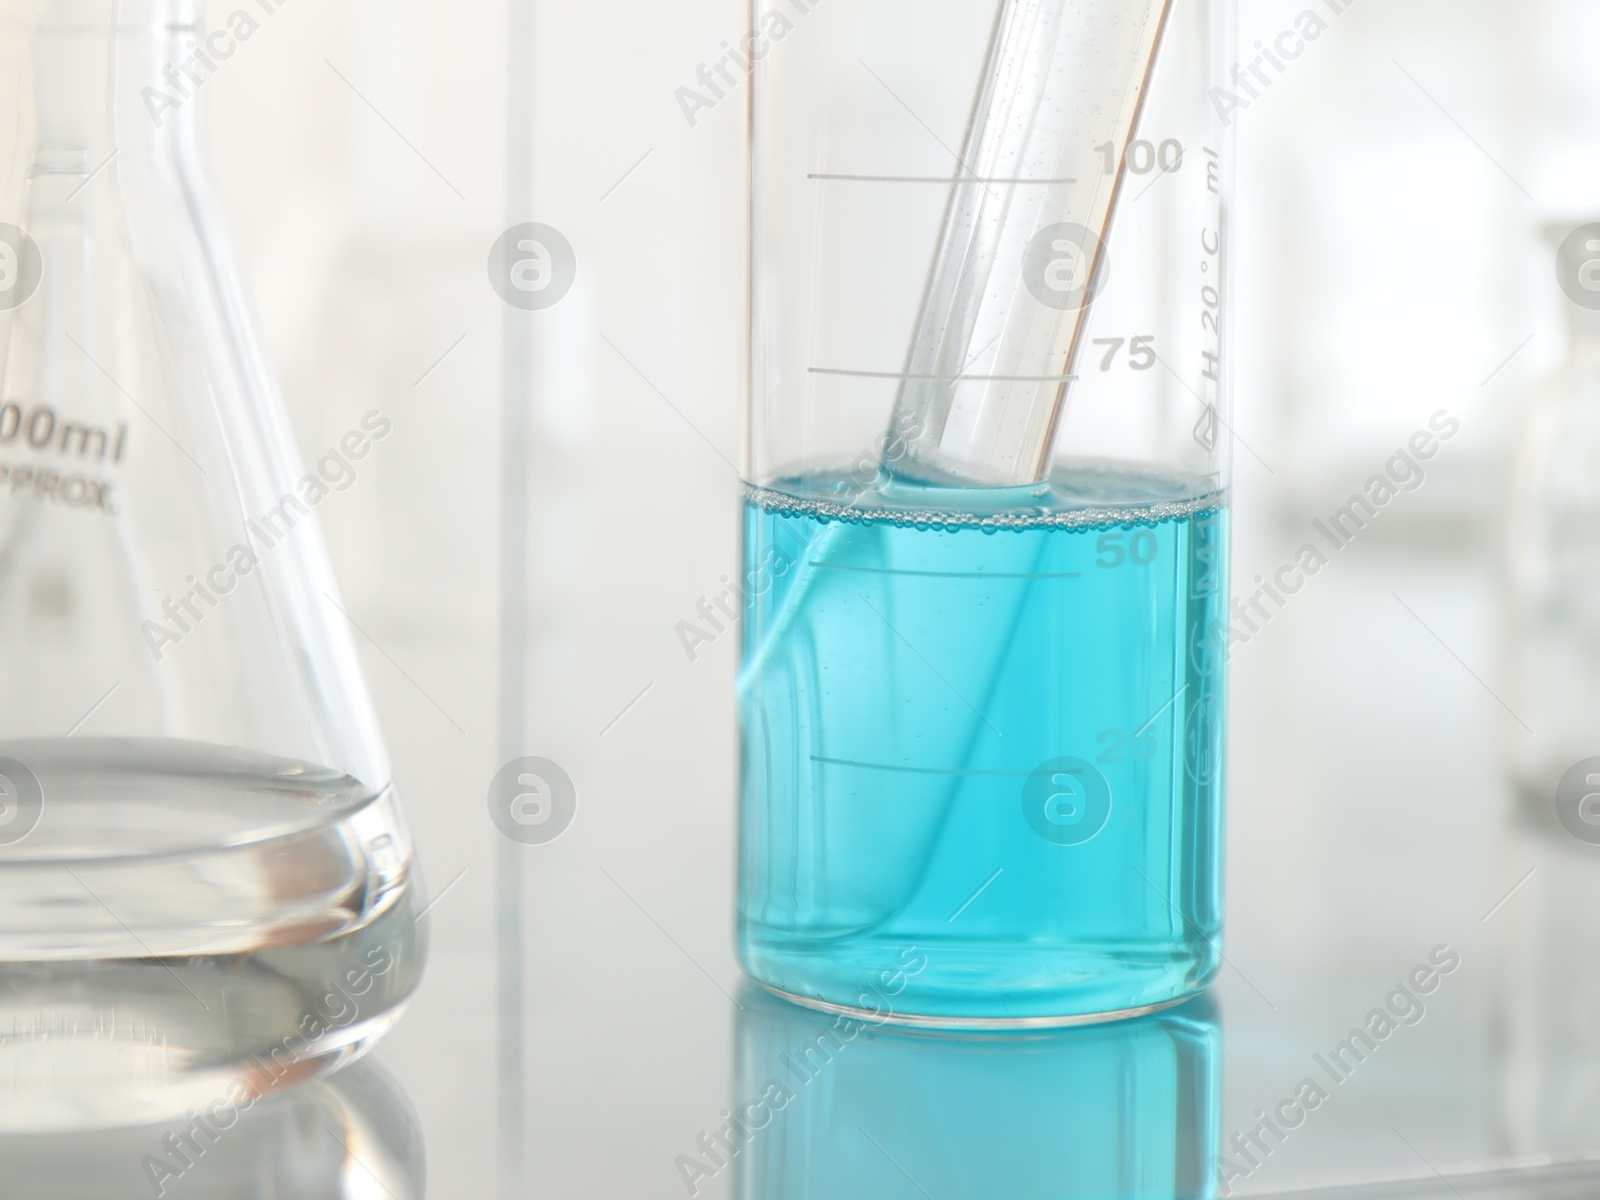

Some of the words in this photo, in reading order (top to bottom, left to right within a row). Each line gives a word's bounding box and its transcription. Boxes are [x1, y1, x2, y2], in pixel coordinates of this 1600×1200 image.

[1094, 139, 1183, 175] 100
[1202, 146, 1219, 195] ml
[1092, 335, 1156, 372] 75
[1094, 530, 1158, 568] 50
